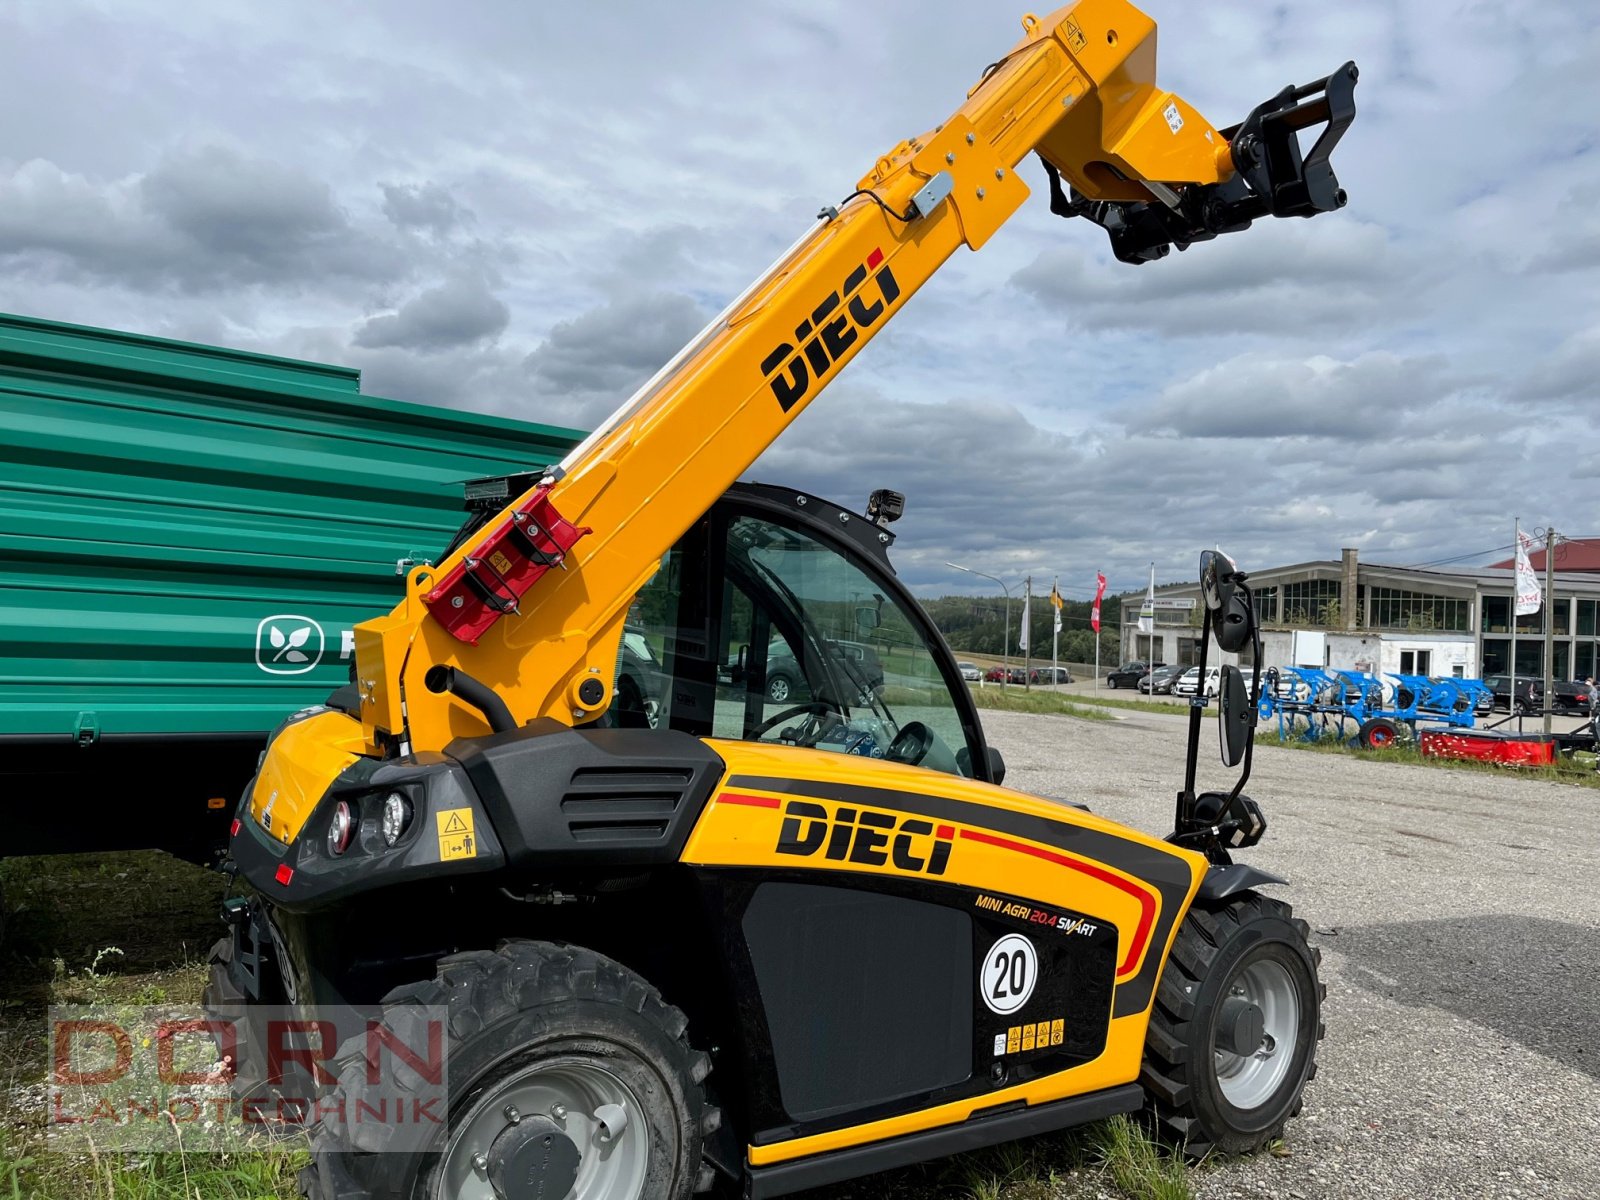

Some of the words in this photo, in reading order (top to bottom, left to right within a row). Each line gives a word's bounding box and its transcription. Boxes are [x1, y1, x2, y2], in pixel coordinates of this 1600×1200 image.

[760, 246, 900, 413] DIECI
[775, 800, 955, 875] DIECI
[975, 894, 1002, 912] MINI
[1001, 902, 1031, 920] AGRI
[1029, 910, 1058, 926] 20.4
[1056, 917, 1097, 937] SMART
[992, 949, 1026, 999] 20
